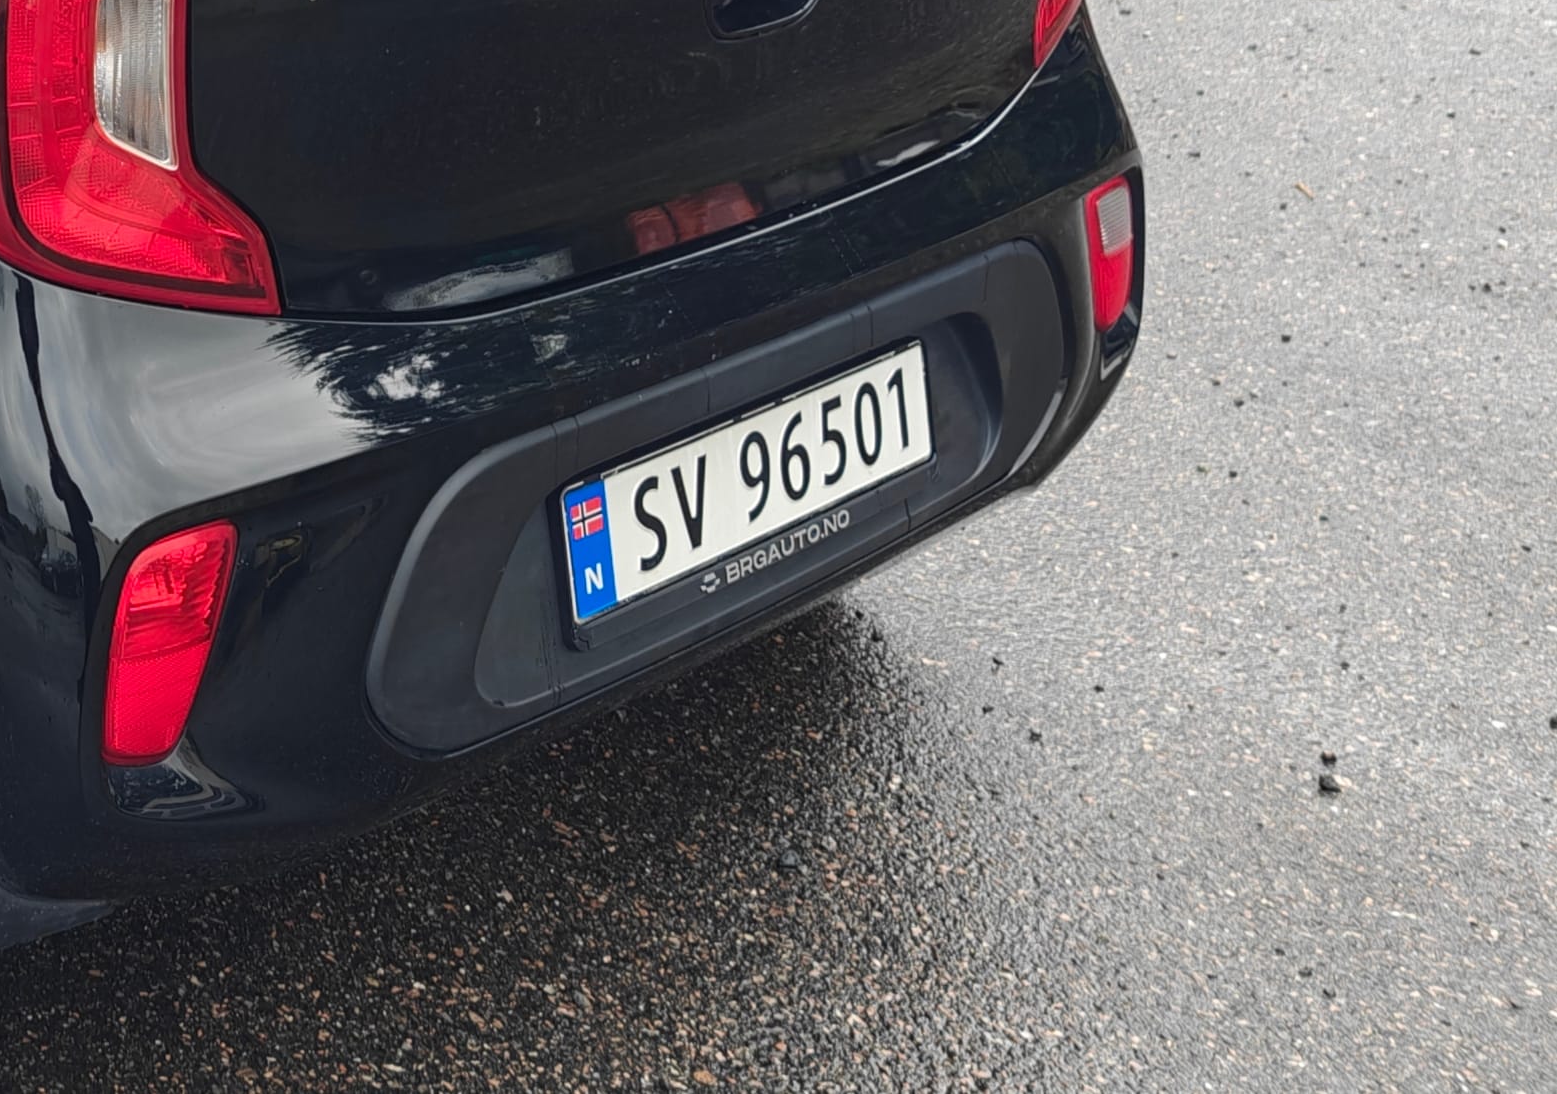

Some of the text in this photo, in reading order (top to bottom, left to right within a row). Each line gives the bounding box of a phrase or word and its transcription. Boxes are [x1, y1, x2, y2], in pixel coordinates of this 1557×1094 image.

[633, 366, 910, 573] SV 96501
[583, 562, 604, 595] N
[724, 509, 850, 584] BRGAUTO.NO
